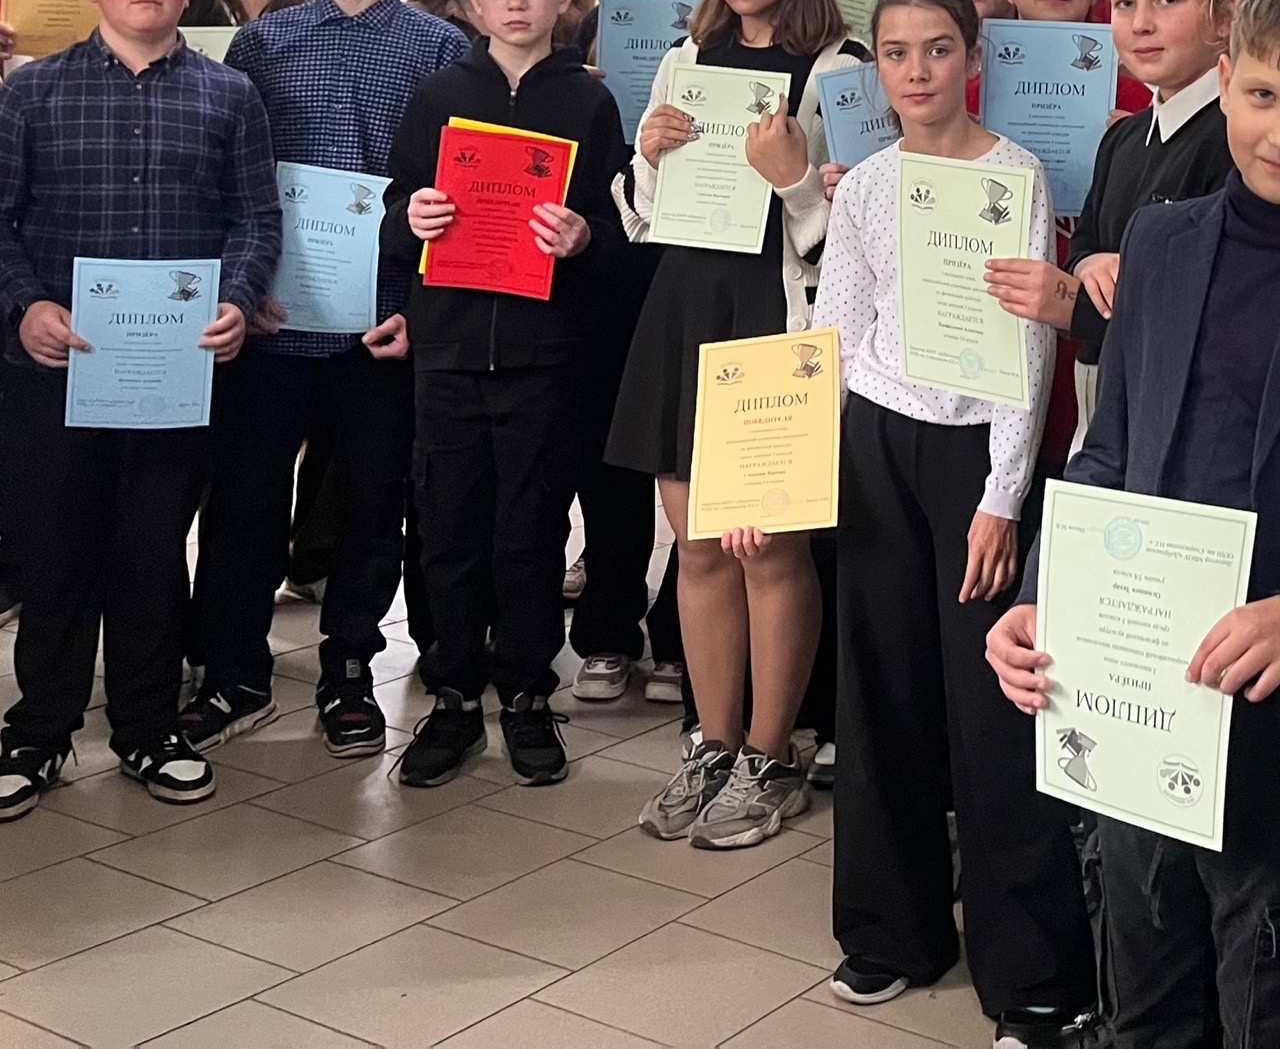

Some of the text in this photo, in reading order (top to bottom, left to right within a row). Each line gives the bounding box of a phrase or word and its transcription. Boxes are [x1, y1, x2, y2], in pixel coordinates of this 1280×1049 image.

[624, 38, 673, 50] ДИПЛО
[1015, 81, 1085, 96] ДИПЛОМ
[697, 120, 745, 138] ДИПЛО
[468, 181, 537, 198] ДИПЛОМ
[295, 218, 356, 237] ДИПЛОМ
[927, 231, 993, 255] ДИПЛОМ
[943, 259, 971, 270] ПРИЗЁРА
[109, 313, 184, 325] ДИПЛОМ
[734, 393, 808, 413] ДИПЛОМ
[1099, 596, 1171, 619] НАГРАЖДАЕТСЯ
[1109, 673, 1151, 691] ПРИЗЁРА
[1076, 689, 1176, 732] ДИПЛОМ
